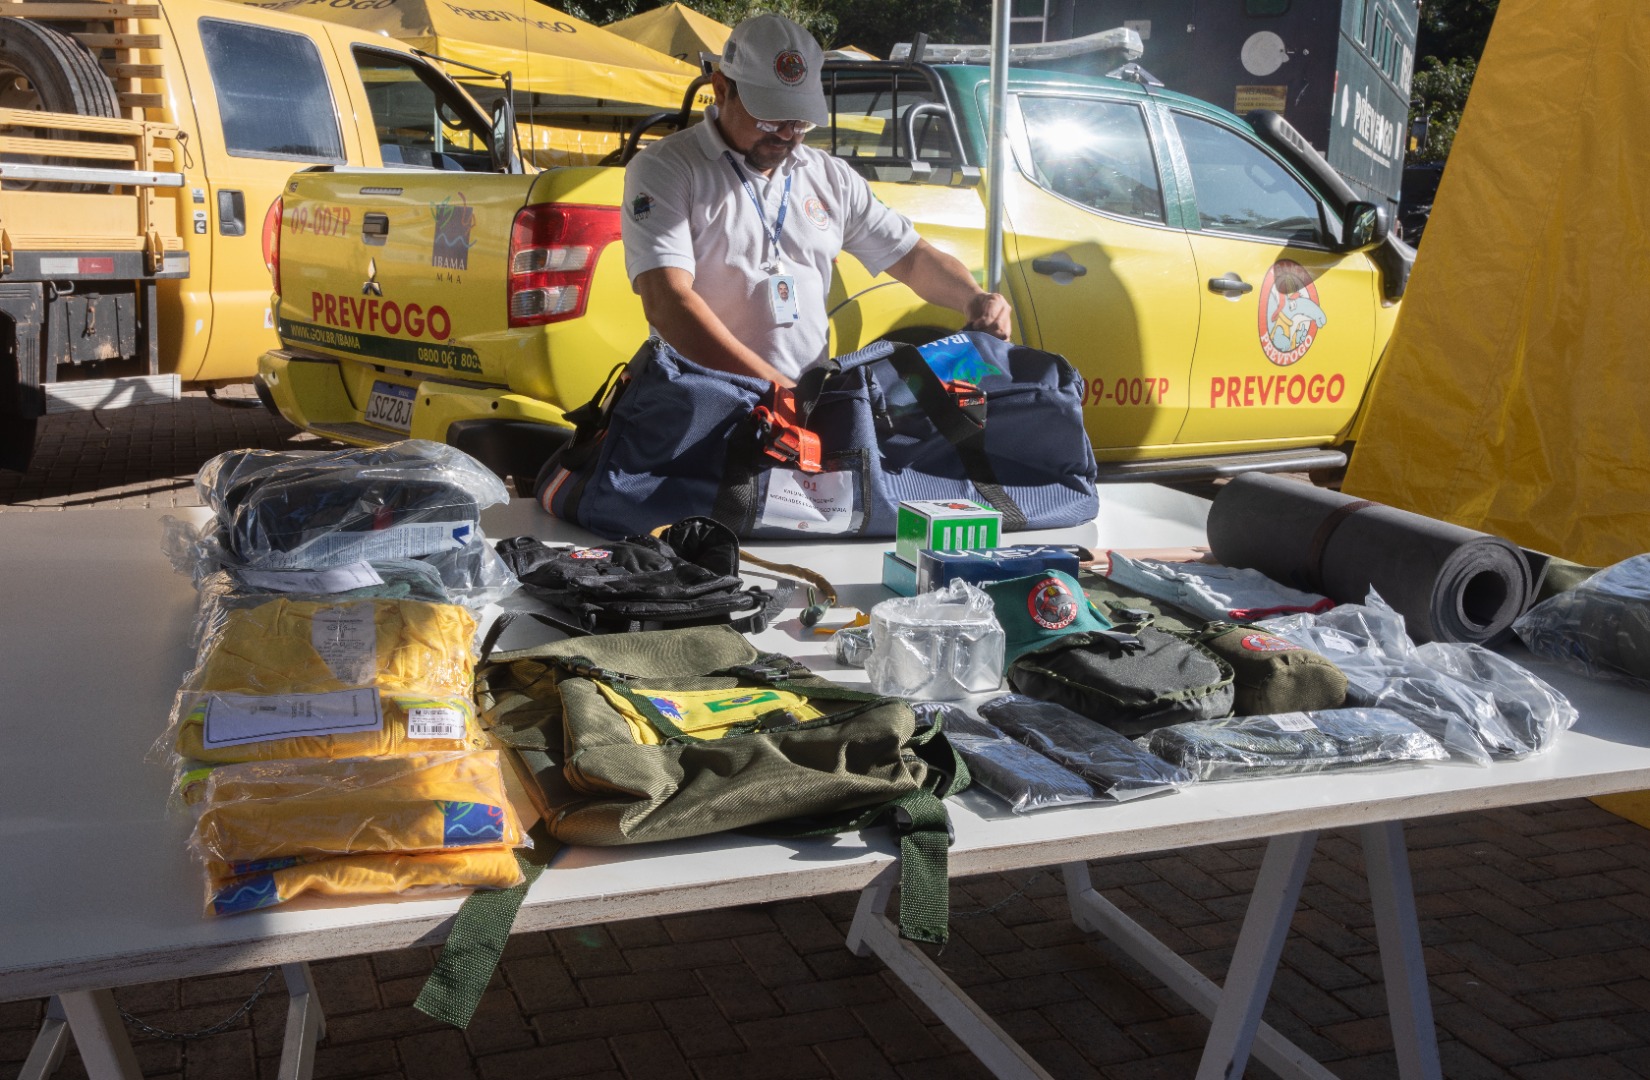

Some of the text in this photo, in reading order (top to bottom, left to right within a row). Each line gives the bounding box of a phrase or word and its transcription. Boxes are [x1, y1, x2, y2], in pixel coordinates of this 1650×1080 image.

[291, 207, 351, 236] 09-007P
[433, 256, 465, 270] IBAMA
[312, 292, 451, 340] PREVFOGO
[418, 347, 439, 363] 0800
[1260, 331, 1313, 364] PREVFOGO
[1210, 373, 1345, 408] PREVFOGO
[372, 396, 412, 426] SCZ8J
[803, 480, 817, 492] 01
